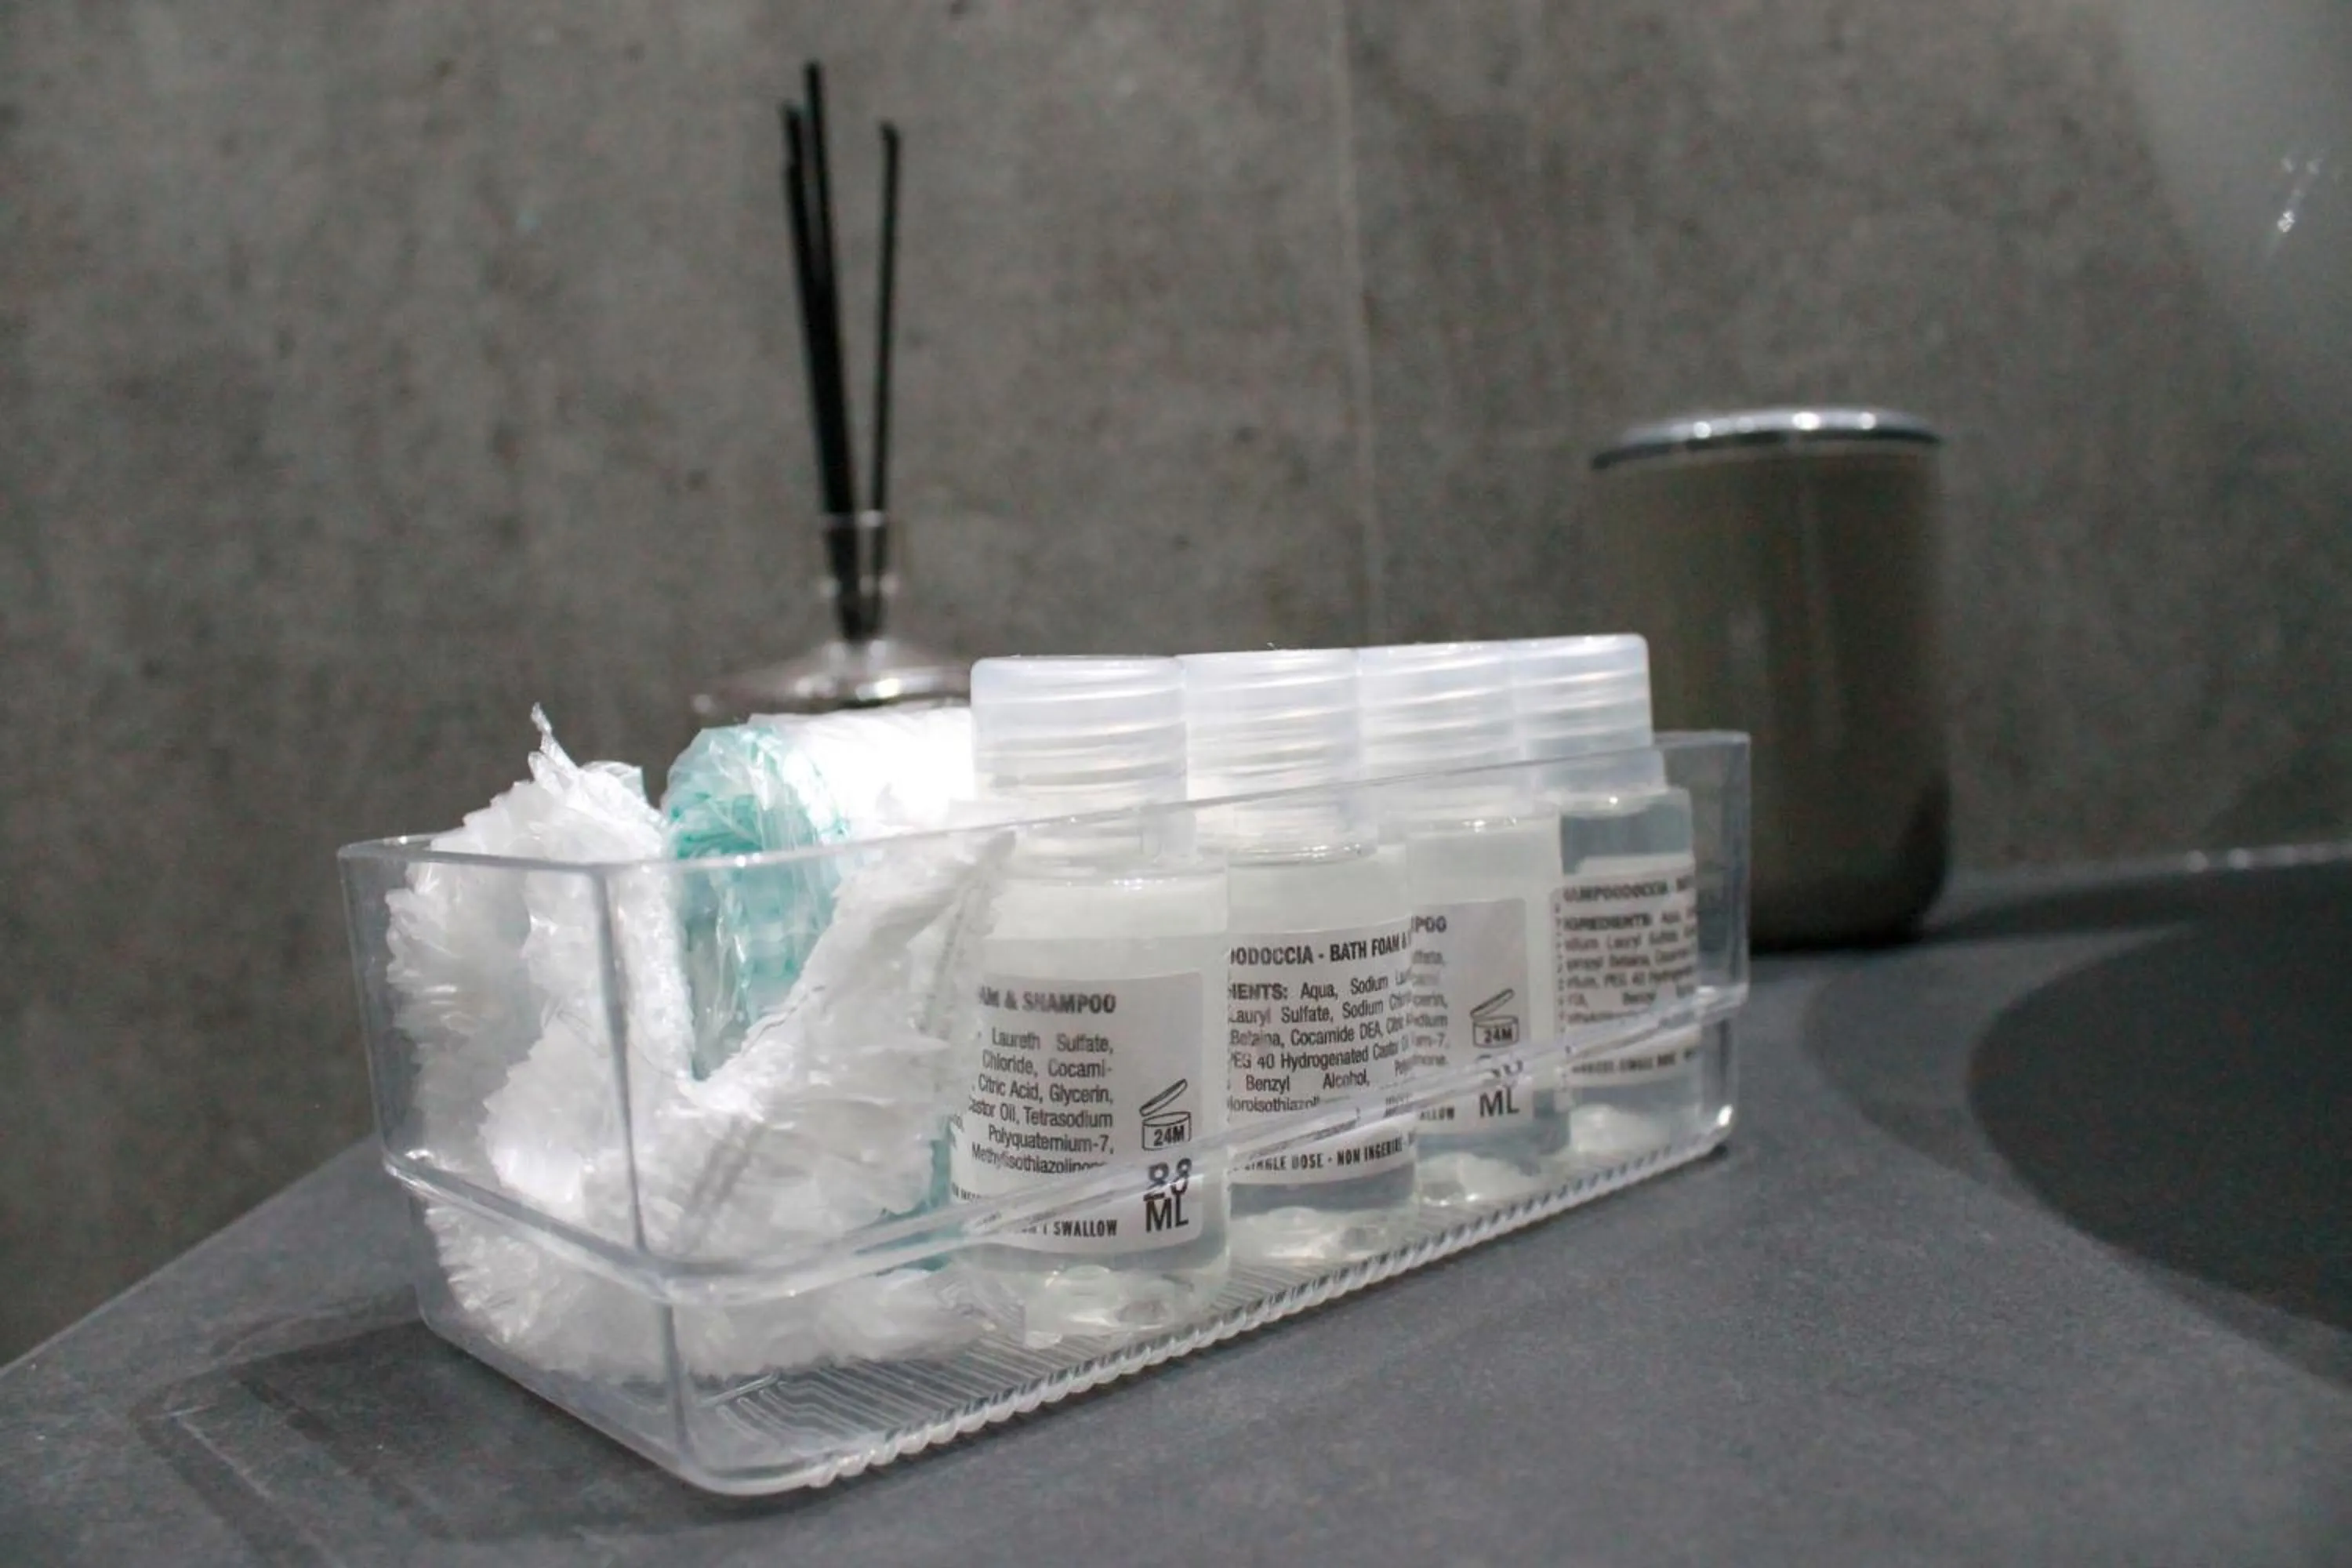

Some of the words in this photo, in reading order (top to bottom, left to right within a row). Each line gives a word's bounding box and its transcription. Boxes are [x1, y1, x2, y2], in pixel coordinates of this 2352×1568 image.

[1412, 916, 1446, 933] POO
[1230, 945, 1313, 965] ODOCCIA
[1330, 939, 1367, 962] BATH
[1371, 933, 1399, 956] FOAM
[1229, 982, 1288, 1000] IENTS:
[1300, 982, 1338, 1002] Aqua,
[1350, 975, 1388, 995] Sodium
[1022, 990, 1117, 1014] SHAMPOO
[1341, 998, 1384, 1019] Sodium
[991, 1026, 1040, 1051] Laureth
[1056, 1032, 1114, 1054] Sulfate,
[1290, 1025, 1355, 1047] Cocamide
[1483, 1028, 1513, 1045] 24M
[982, 1048, 1038, 1078] Chloride,
[1048, 1058, 1113, 1079] Cocami-
[1257, 1053, 1275, 1069] 40
[1280, 1047, 1369, 1073] Hydrogenated
[978, 1073, 1007, 1096] Citric
[1010, 1080, 1044, 1104] Acid,
[1049, 1082, 1114, 1106] Glycerin,
[1245, 1074, 1290, 1094] Benzyl
[1323, 1069, 1370, 1090] Alcohol,
[968, 1094, 996, 1118] astor
[1000, 1102, 1021, 1125] Oil,
[1022, 1106, 1113, 1129] Tetrasodium
[1479, 1087, 1521, 1119] ML
[1152, 1124, 1185, 1147] 24M
[1337, 1147, 1361, 1167] NON
[1145, 1194, 1189, 1233] ML
[1053, 1219, 1118, 1238] SWALLOW
